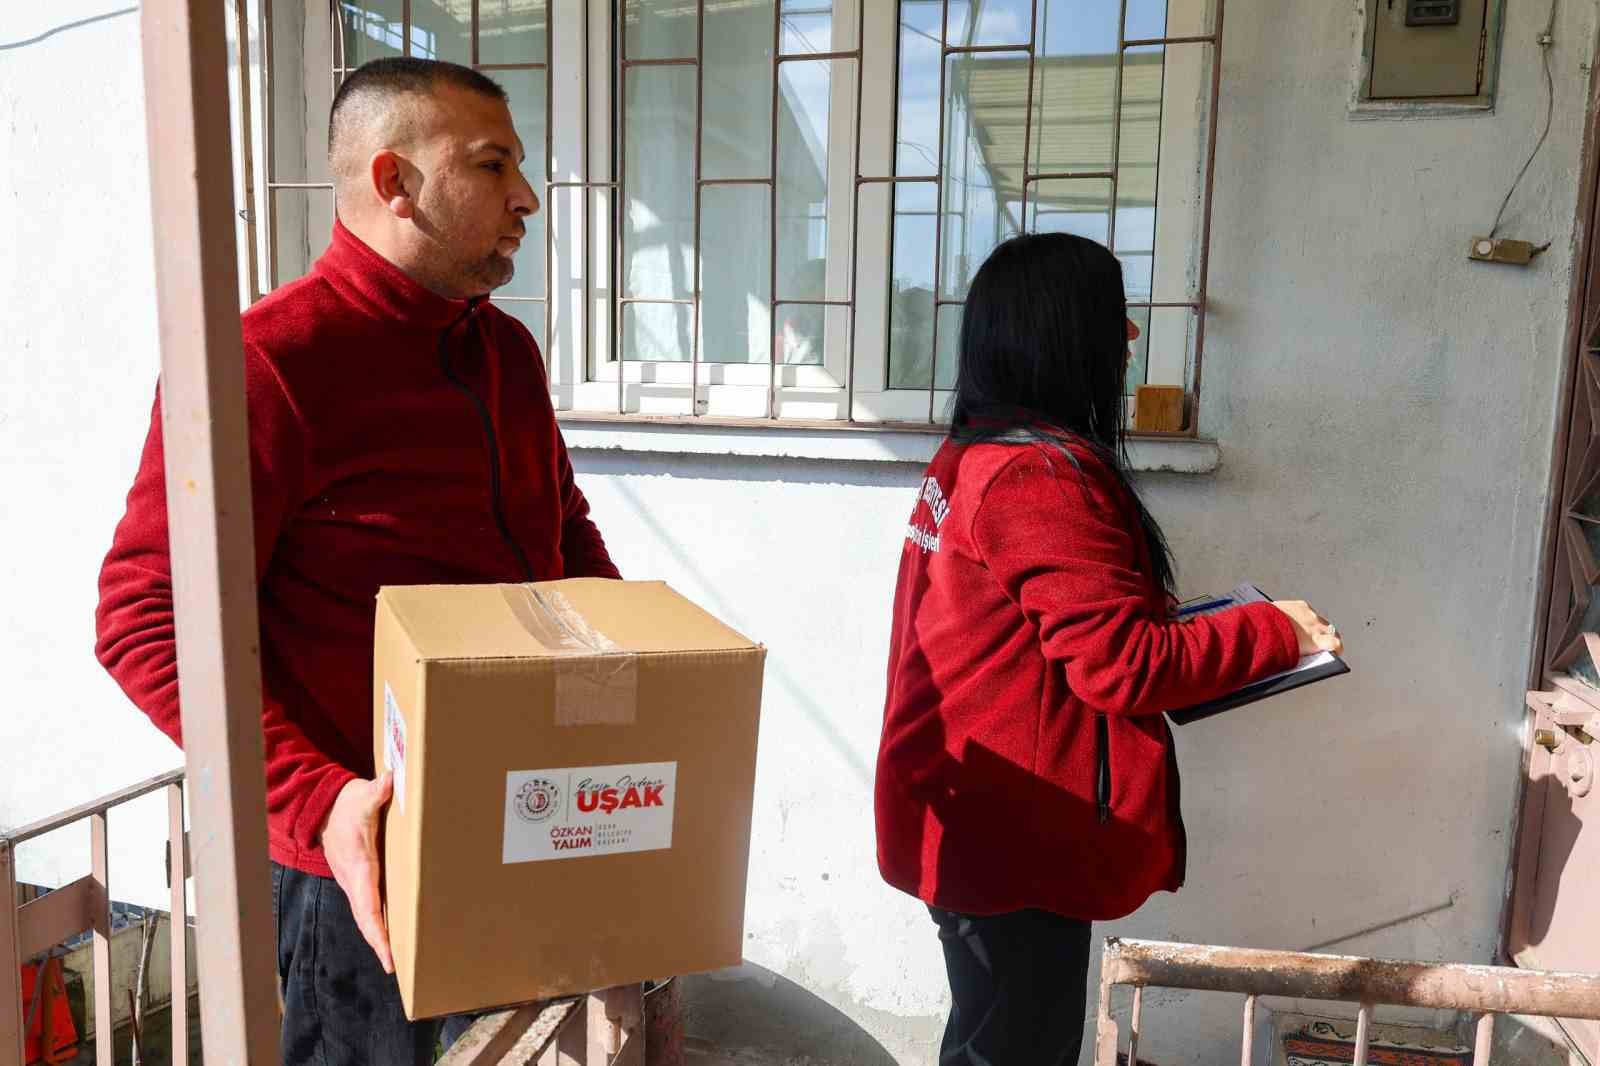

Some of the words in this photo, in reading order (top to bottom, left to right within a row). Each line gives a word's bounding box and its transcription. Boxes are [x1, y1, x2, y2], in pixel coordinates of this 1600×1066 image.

[577, 785, 664, 814] UŞAK
[551, 824, 592, 838] ÖZKAN
[552, 837, 592, 850] YALIM
